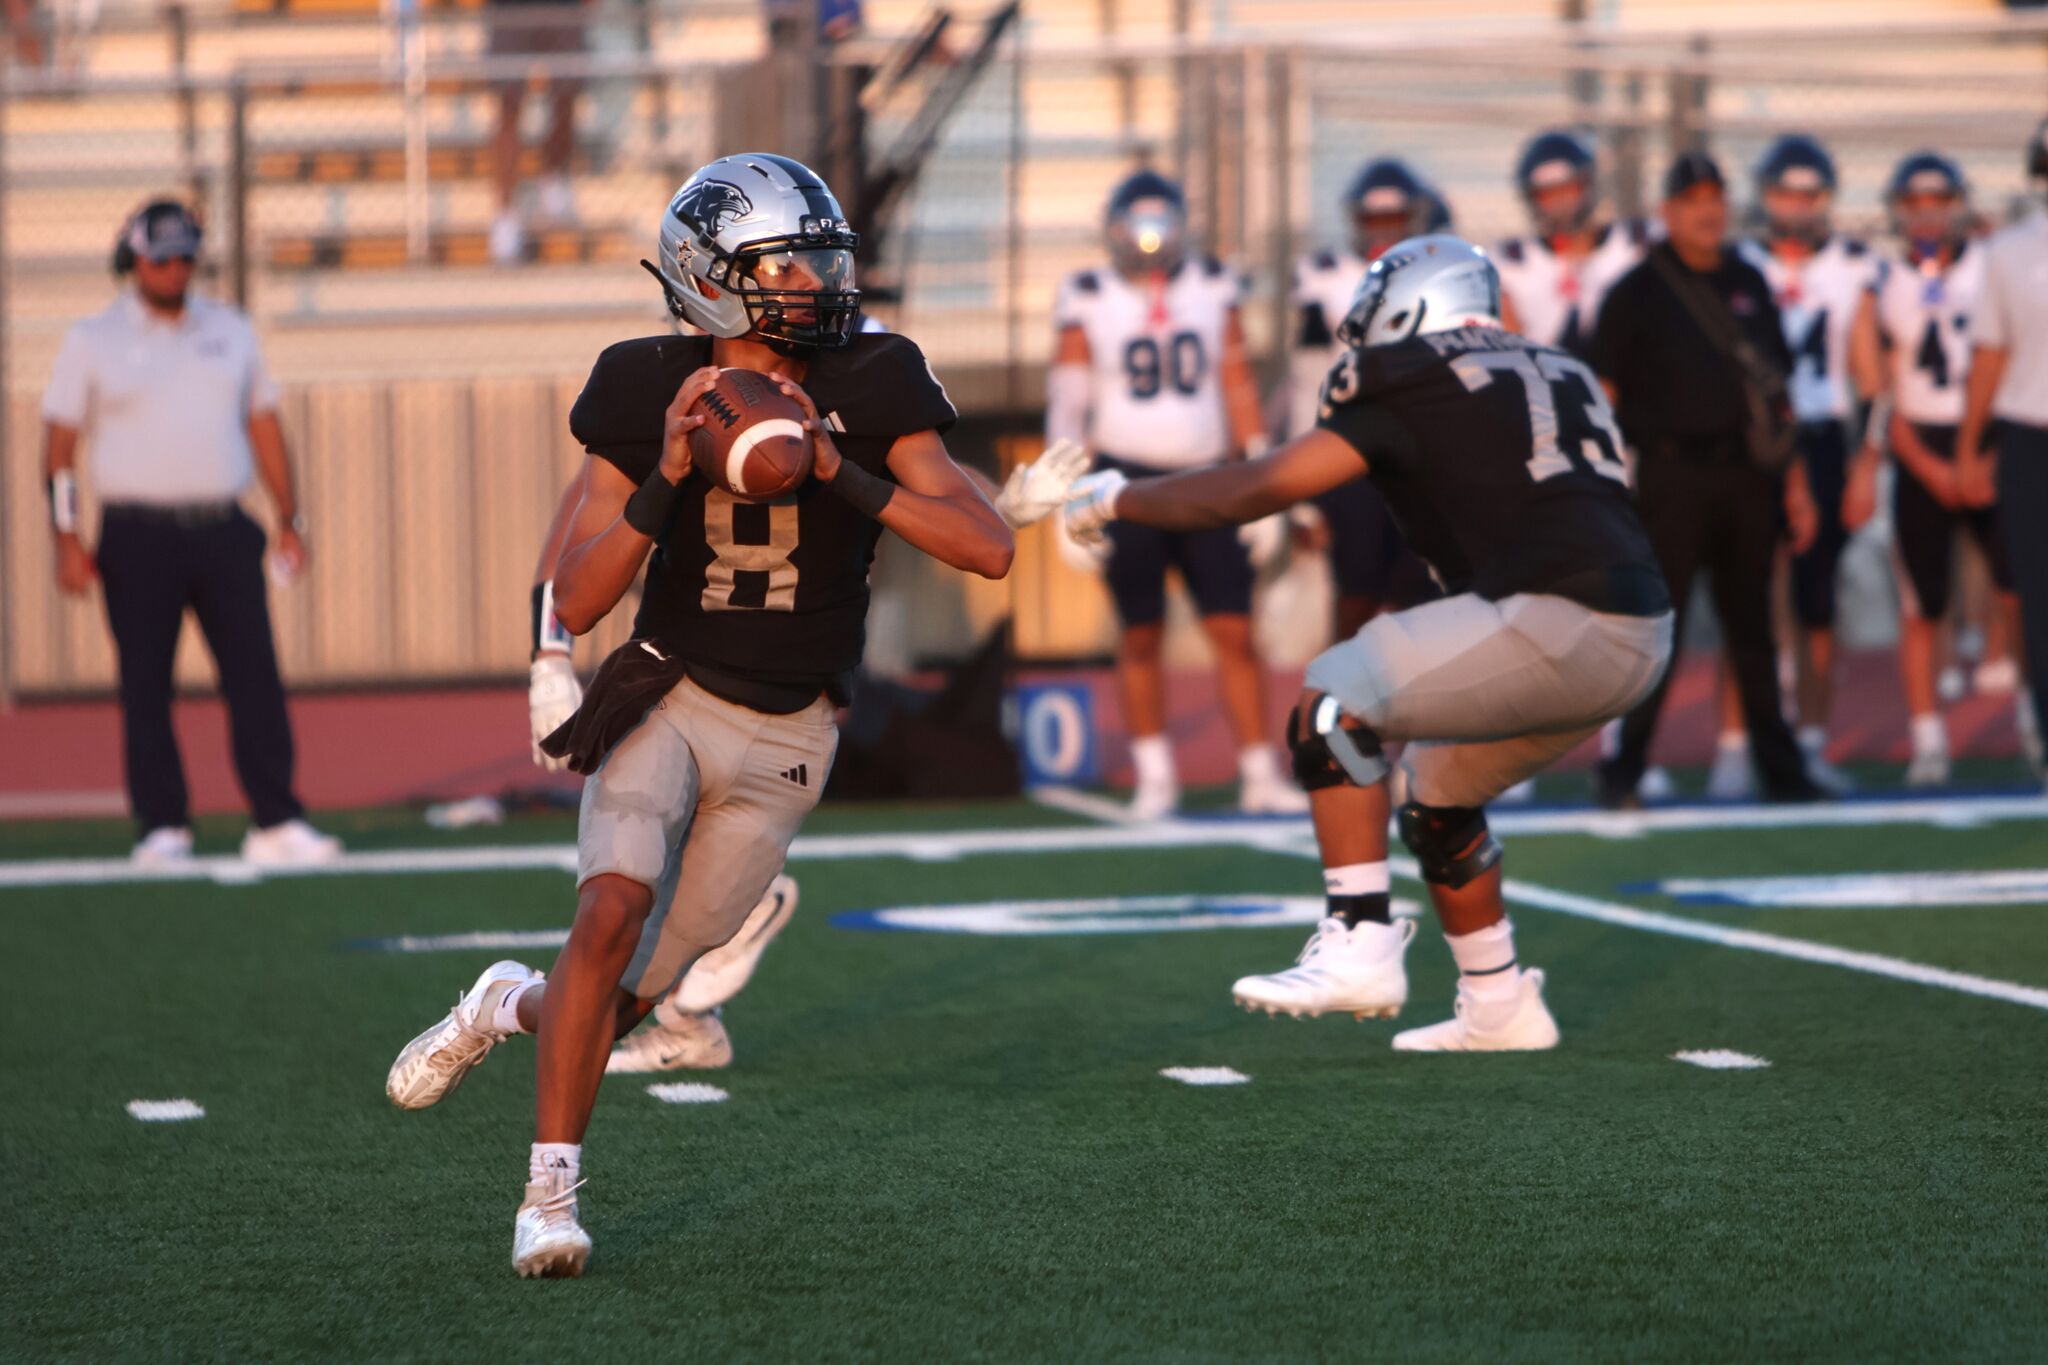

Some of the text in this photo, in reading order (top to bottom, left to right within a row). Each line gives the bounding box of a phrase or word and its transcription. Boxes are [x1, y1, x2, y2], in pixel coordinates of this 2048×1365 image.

[1125, 331, 1204, 399] 90
[1449, 350, 1637, 489] 73
[701, 486, 798, 612] 8
[1002, 690, 1084, 778] 0
